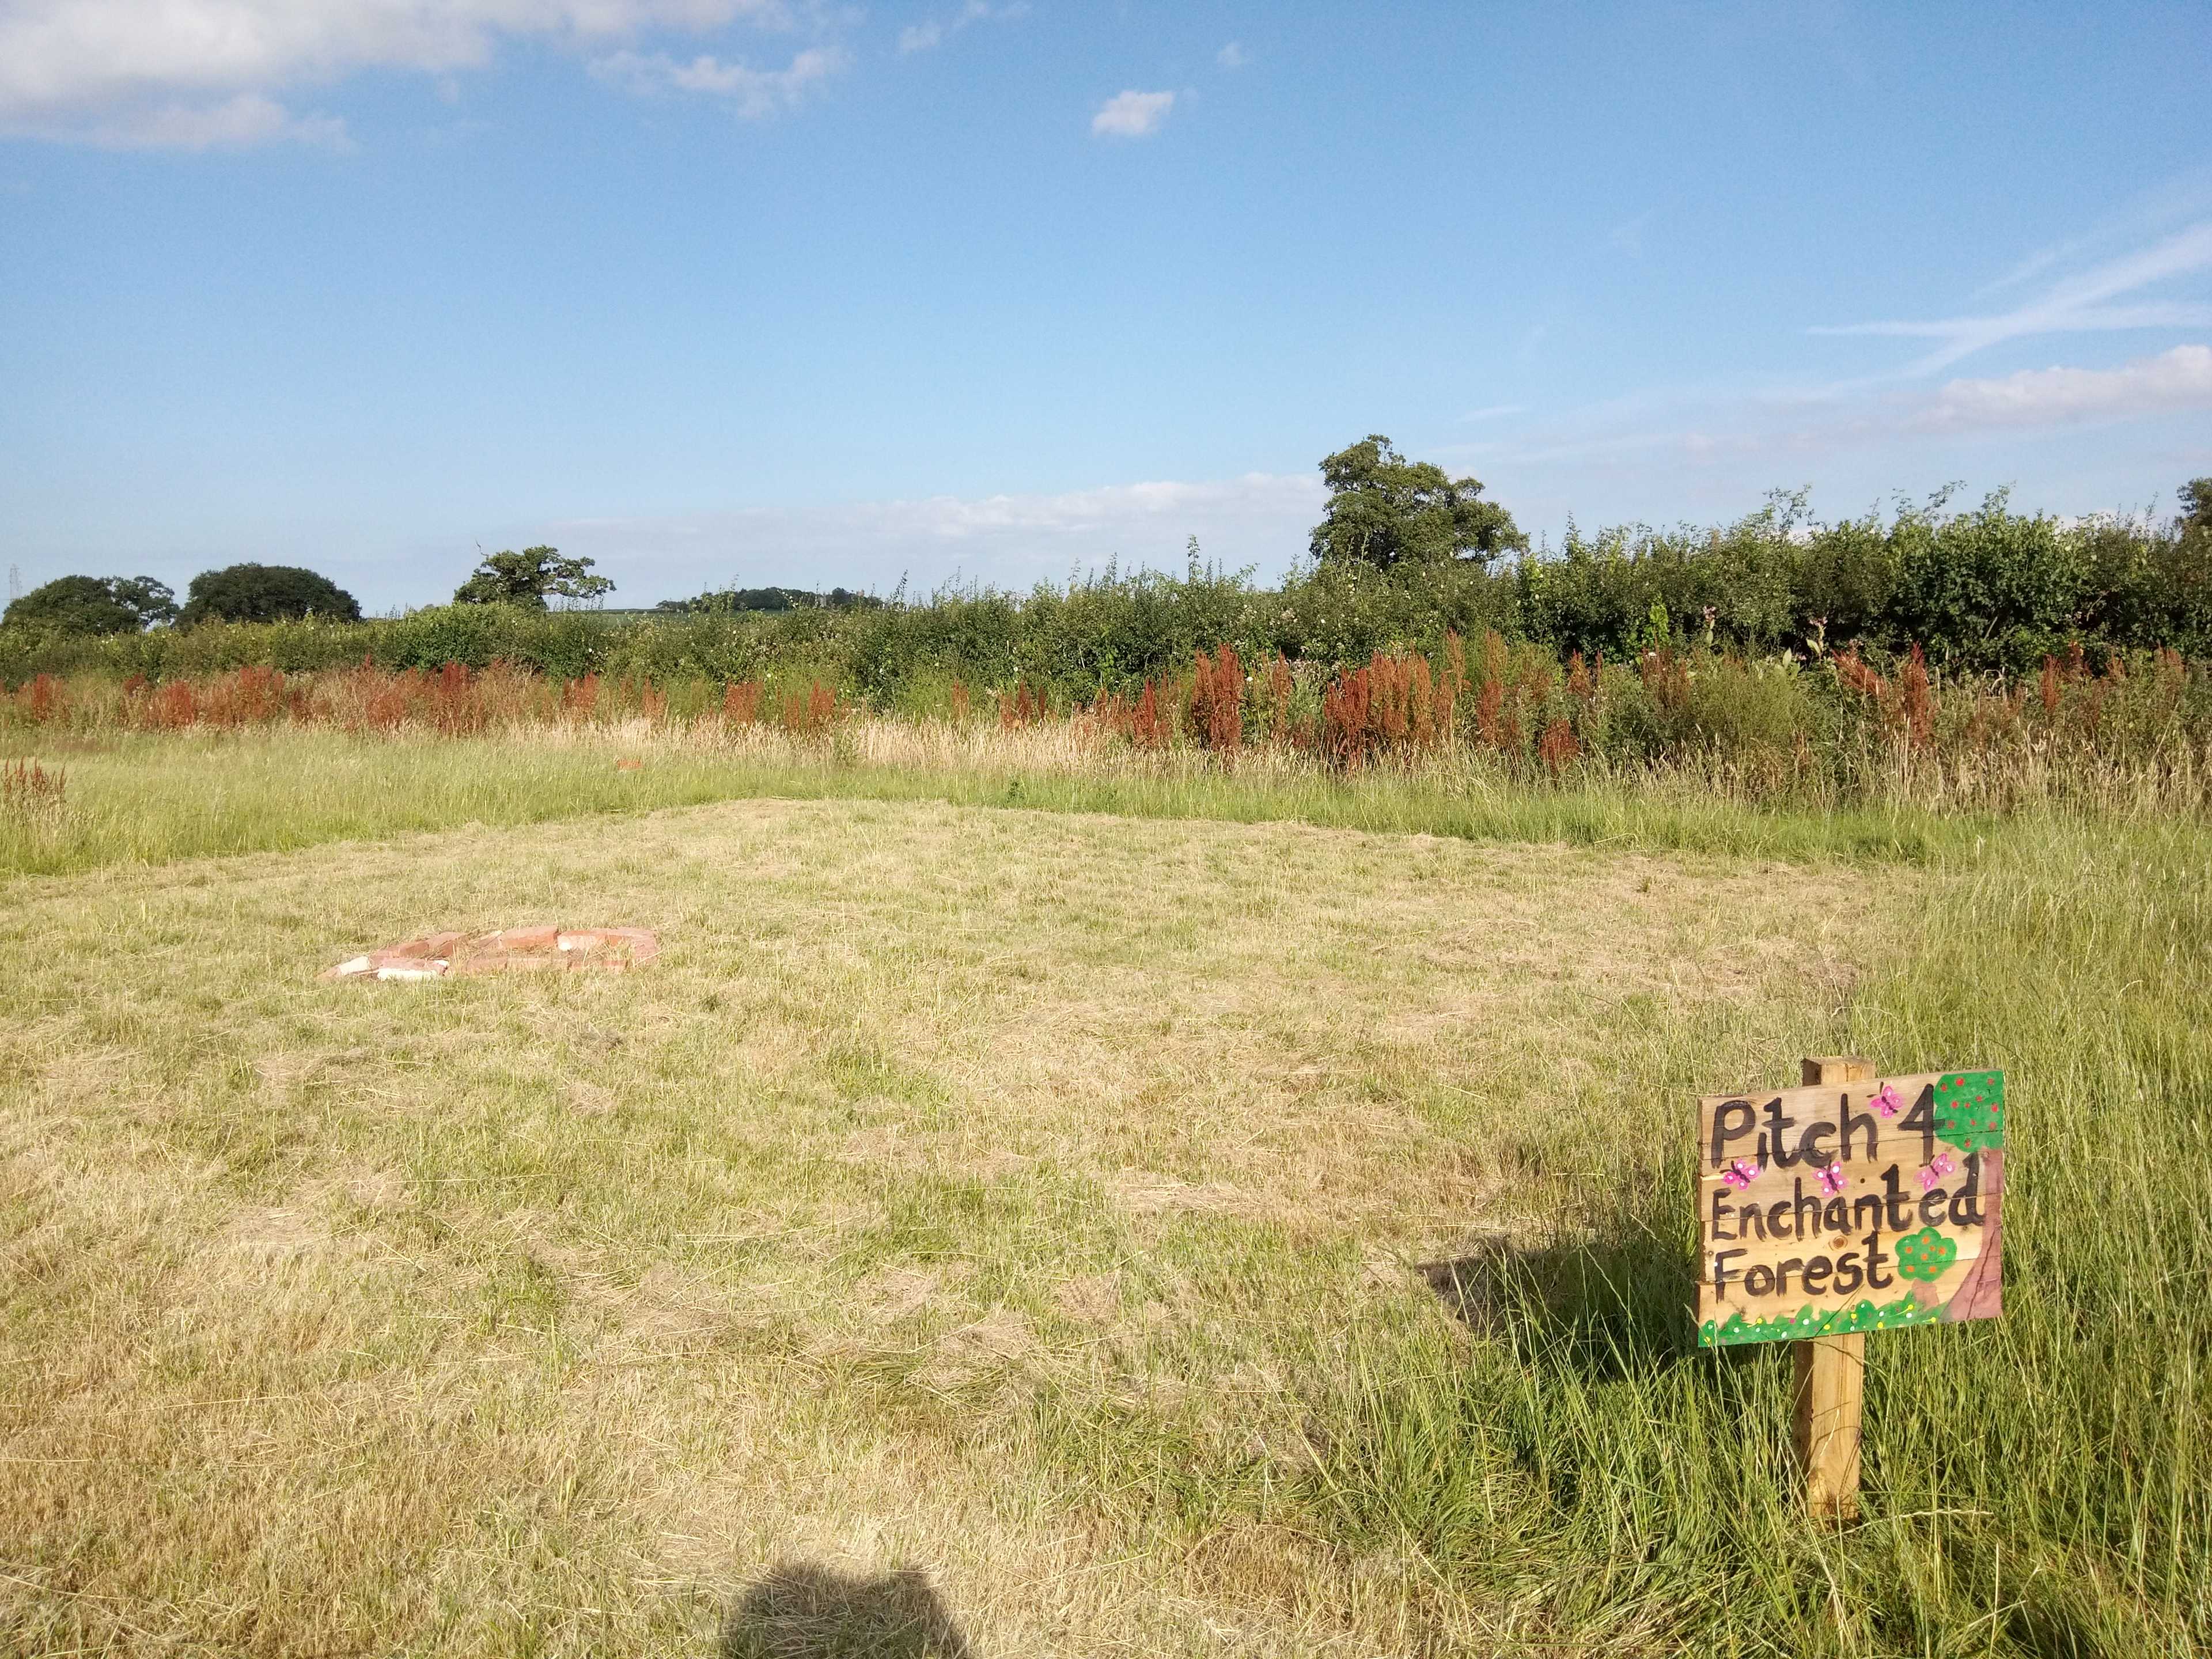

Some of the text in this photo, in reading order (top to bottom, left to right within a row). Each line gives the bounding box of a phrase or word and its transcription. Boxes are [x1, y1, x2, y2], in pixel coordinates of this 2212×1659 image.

[1710, 1083, 1946, 1172] Pitch 4
[1711, 1153, 1986, 1242] Enchanted
[1715, 1230, 1894, 1304] Forest
